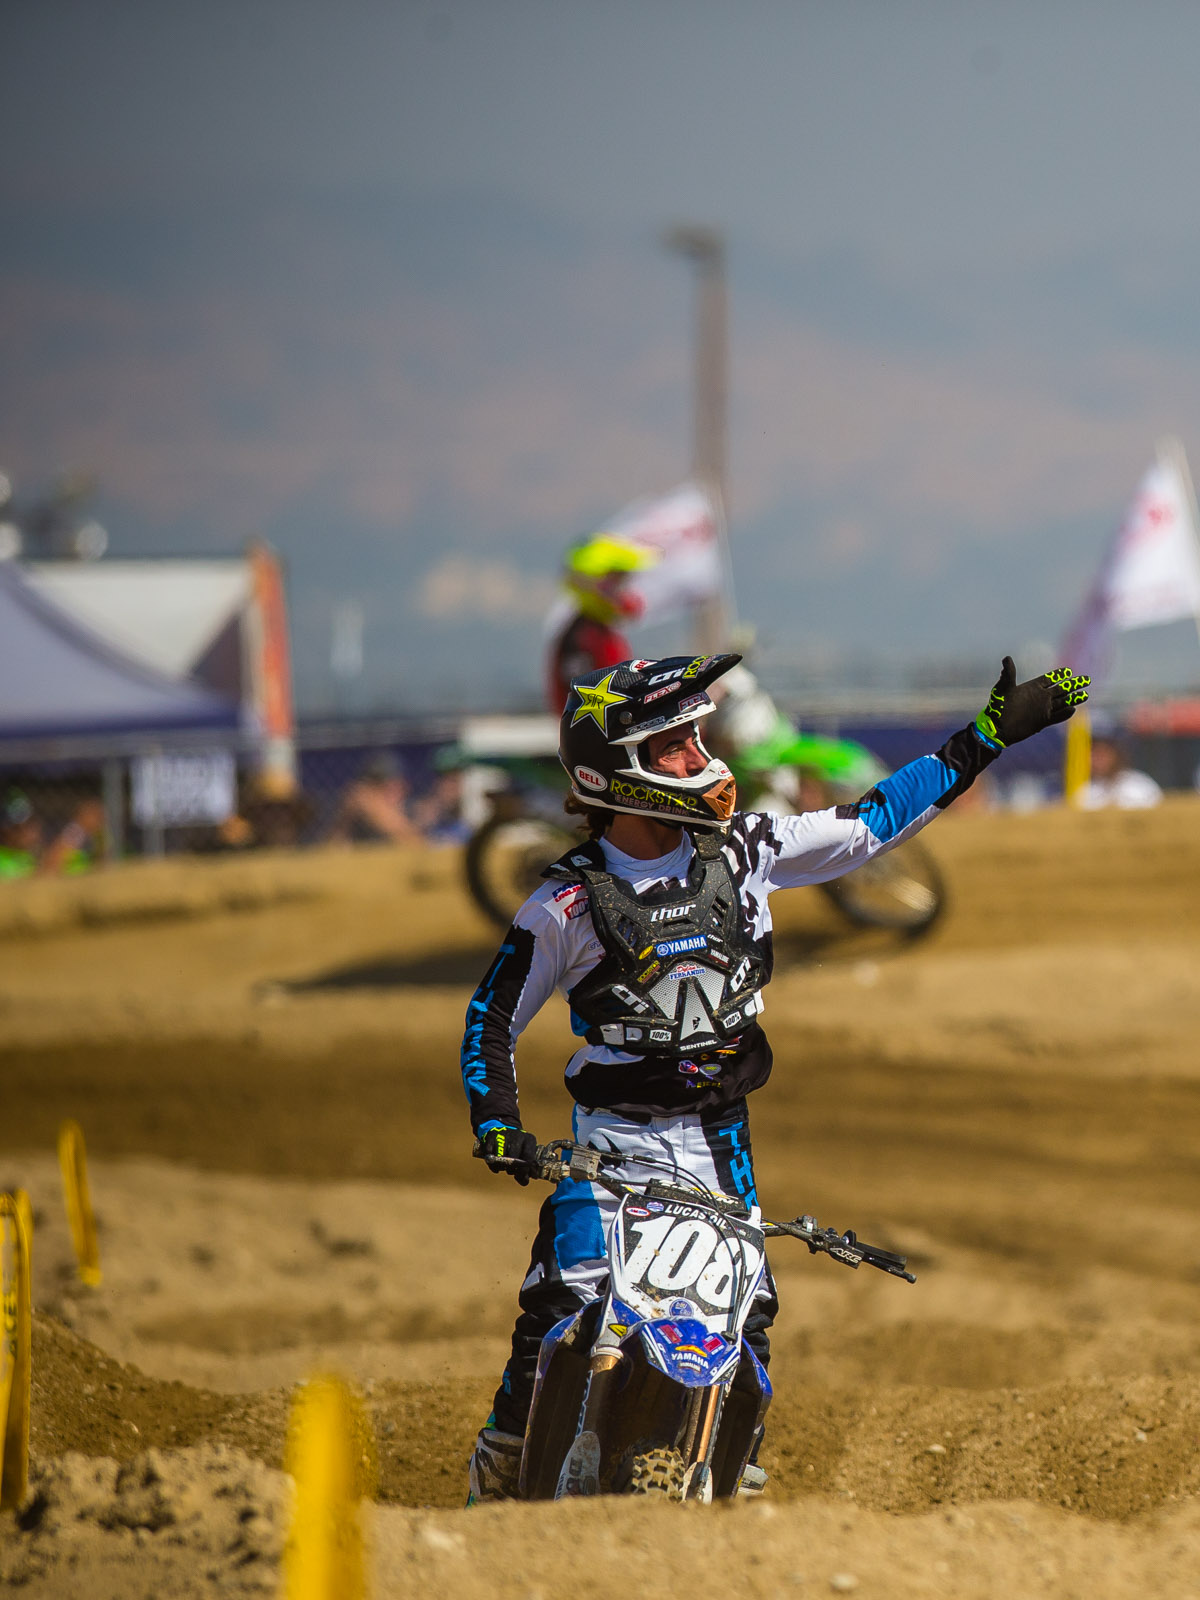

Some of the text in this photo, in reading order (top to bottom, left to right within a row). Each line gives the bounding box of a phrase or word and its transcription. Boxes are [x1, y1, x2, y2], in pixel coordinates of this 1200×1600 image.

[579, 769, 601, 786] BELL
[611, 779, 697, 806] ROCKSTAR
[615, 795, 689, 816] ENERGY DRINK
[651, 904, 697, 922] thor
[668, 937, 707, 953] YAMAHA
[725, 1015, 741, 1027] 100%
[651, 1031, 670, 1041] 100%
[679, 1039, 717, 1051] SENTINEL
[665, 1204, 706, 1220] LUCAS
[710, 1214, 728, 1230] OIL
[623, 1215, 760, 1309] 108
[829, 1247, 863, 1263] ARC
[671, 1352, 709, 1369] YAMAHA
